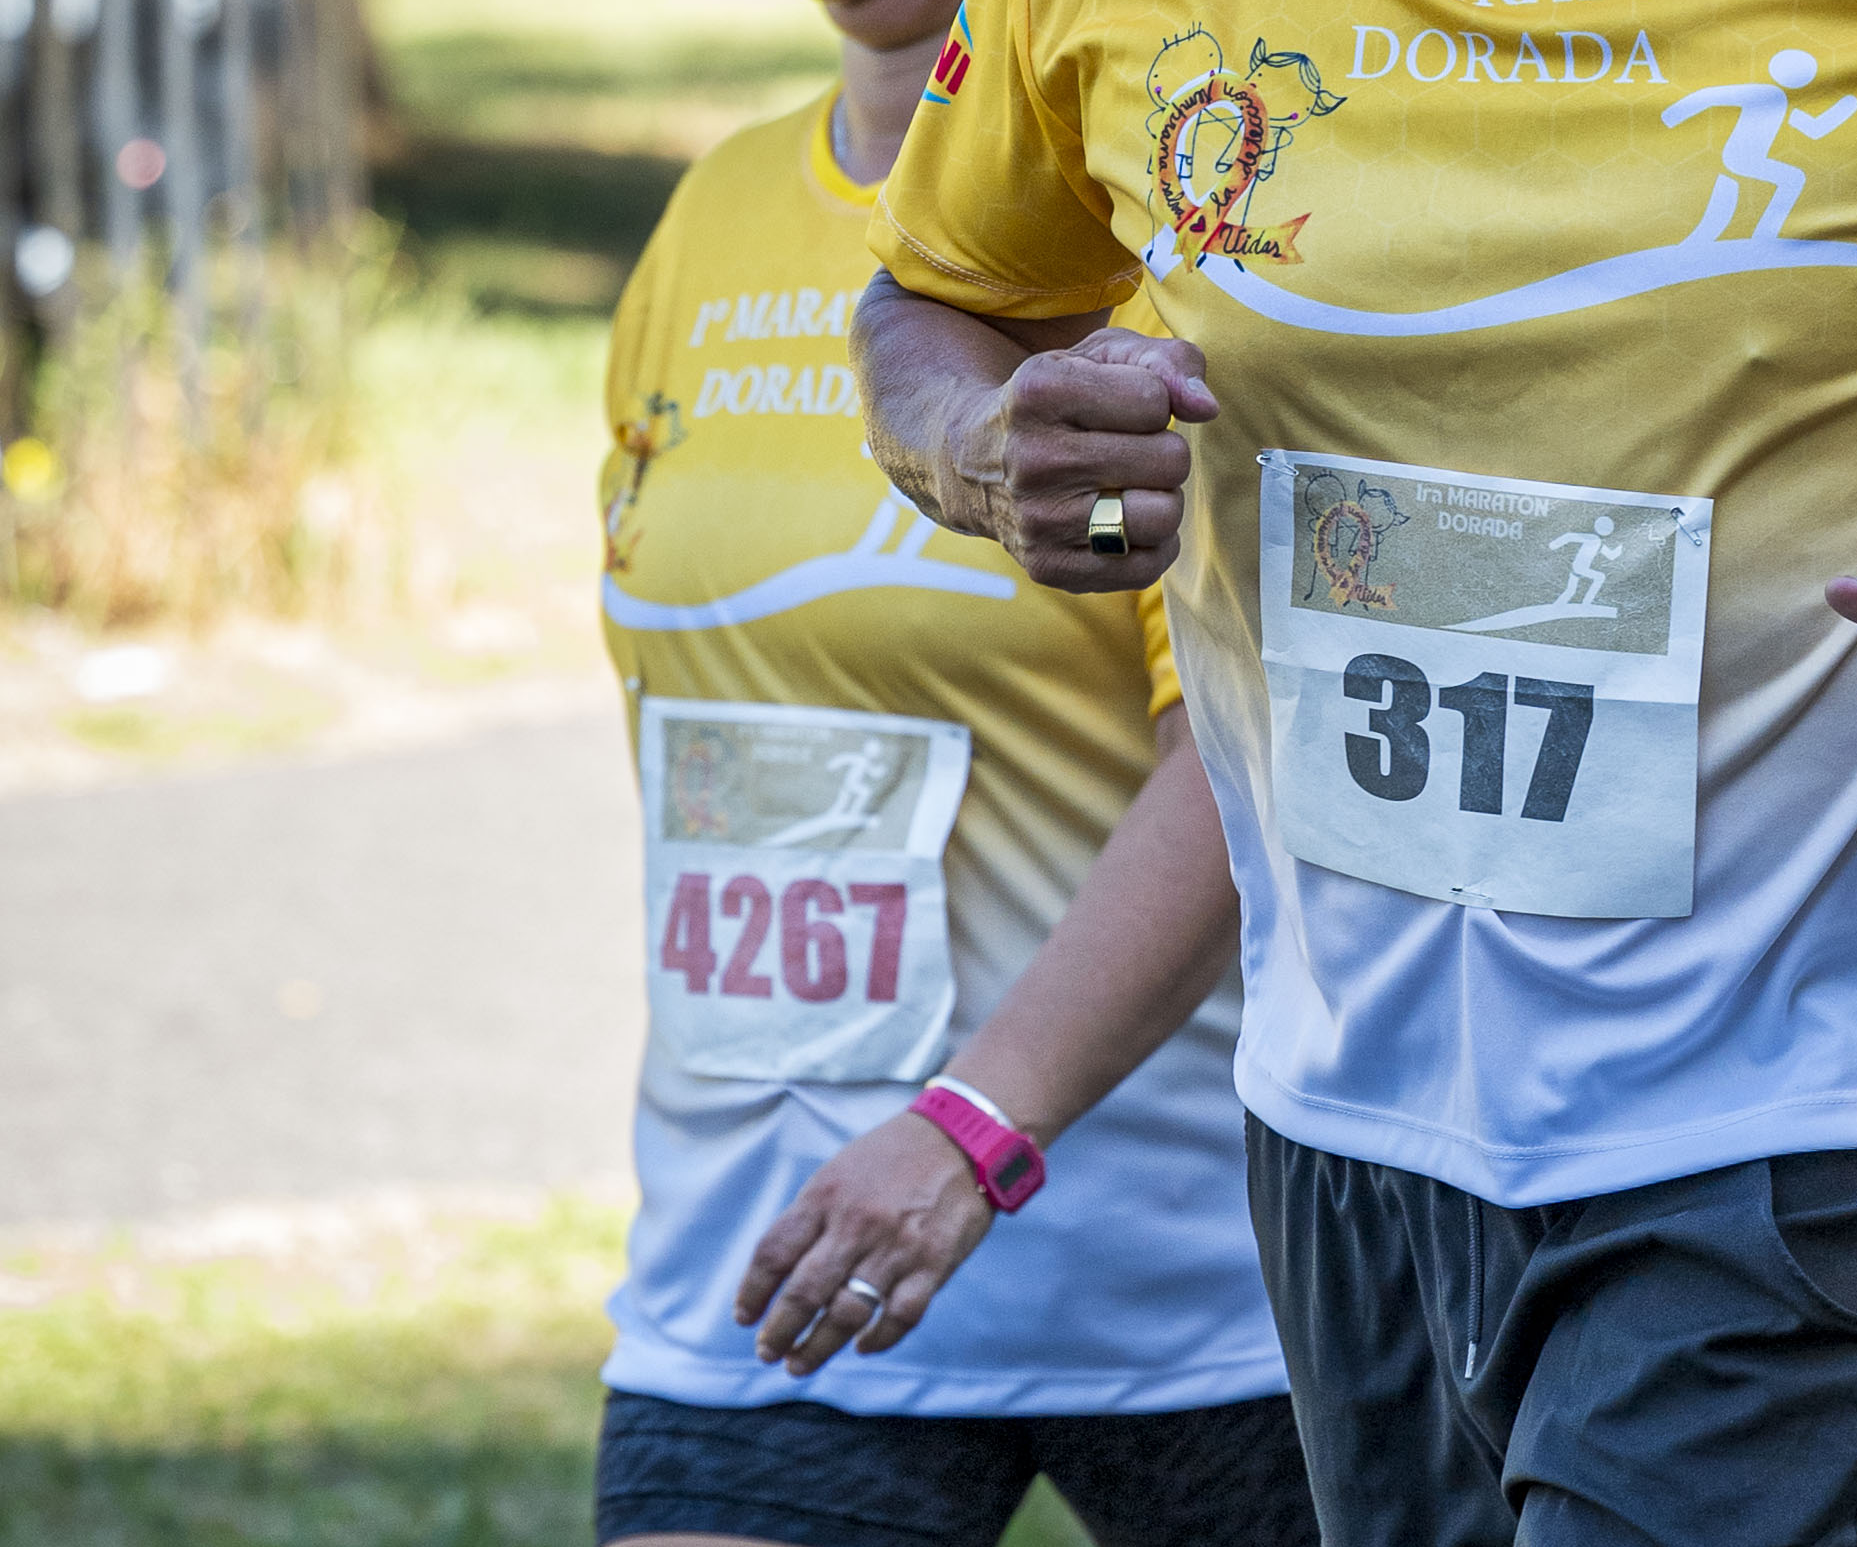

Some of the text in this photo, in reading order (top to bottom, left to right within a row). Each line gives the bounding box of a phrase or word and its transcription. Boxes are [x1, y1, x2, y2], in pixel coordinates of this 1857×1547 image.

[1346, 25, 1669, 84] DORADA
[723, 287, 866, 343] MARA
[1437, 511, 1524, 541] DORADA
[1343, 652, 1595, 823] 317
[660, 872, 908, 1004] 4267
